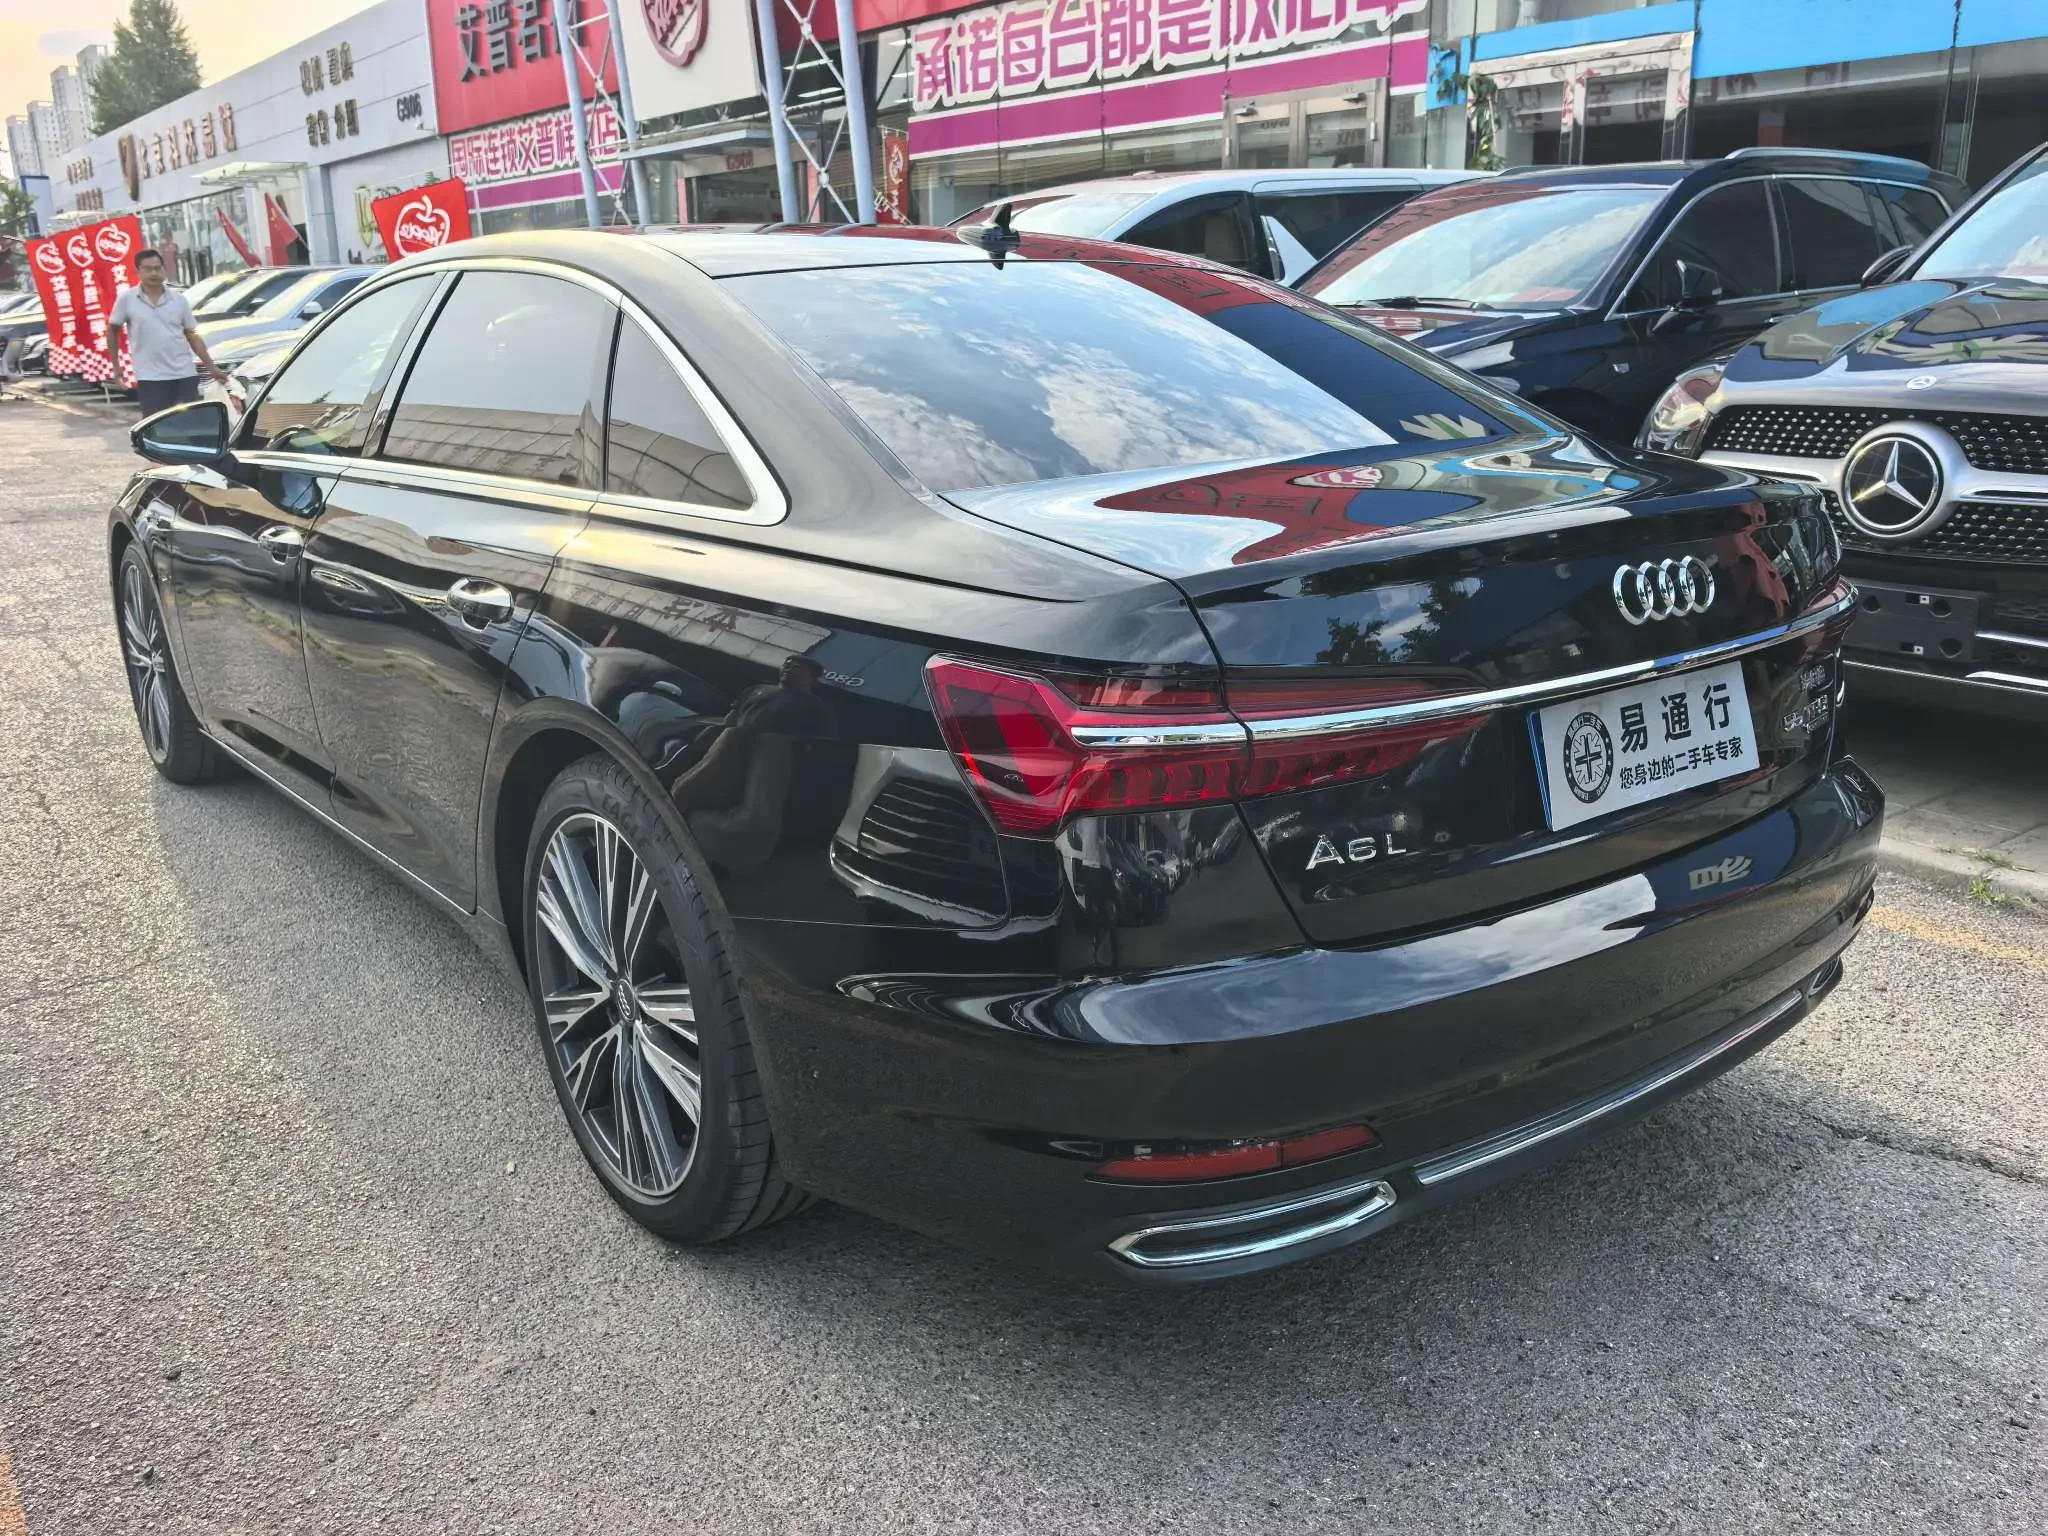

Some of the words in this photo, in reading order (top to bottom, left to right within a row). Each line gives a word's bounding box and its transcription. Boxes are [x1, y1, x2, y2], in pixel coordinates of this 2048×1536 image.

[455, 0, 585, 82] 艾普君
[915, 0, 1413, 103] 承诺每台都是放
[1619, 683, 1731, 754] 易通行
[1619, 736, 1744, 790] 您身边的二手车专家
[1305, 834, 1407, 871] A6L
